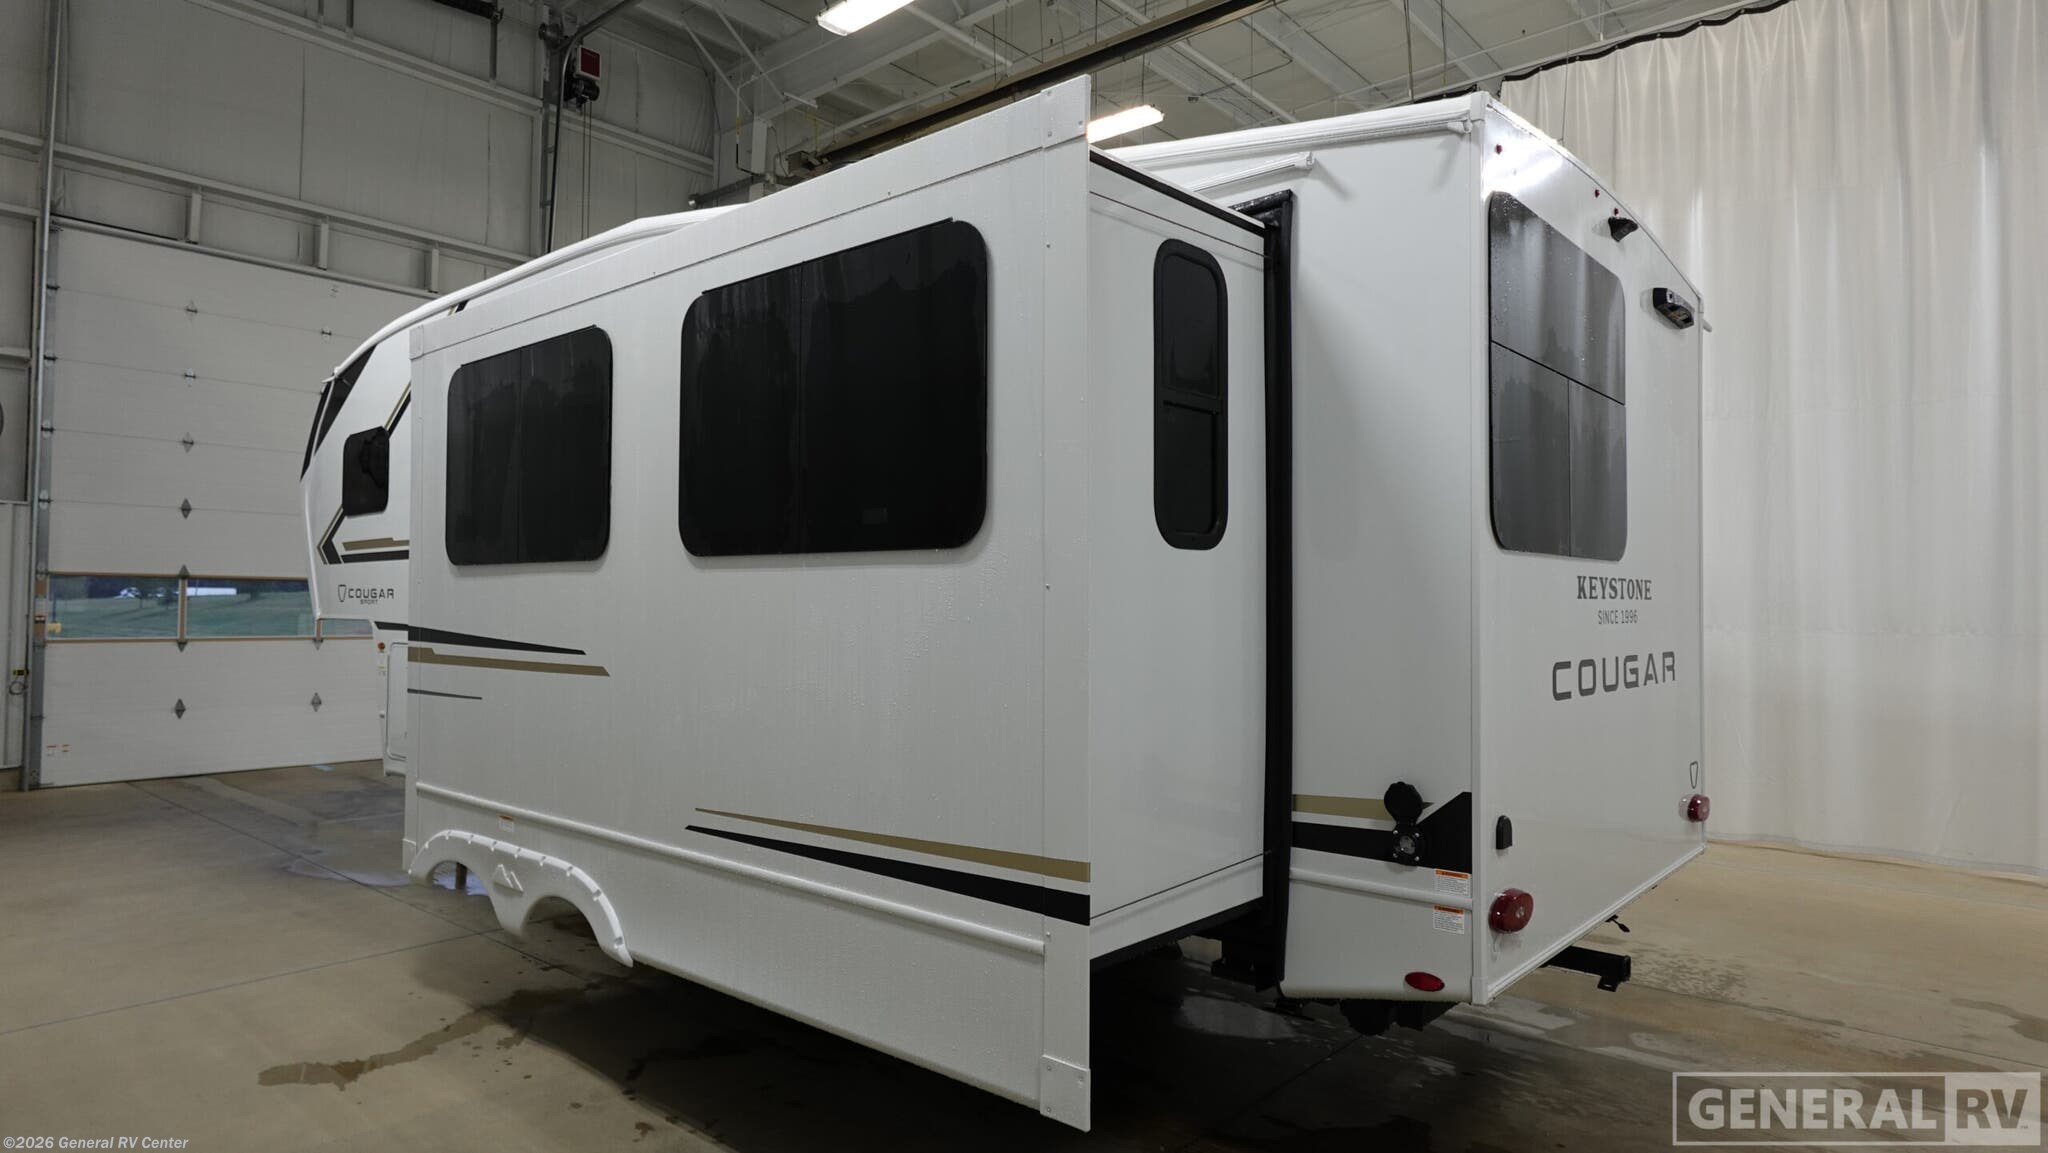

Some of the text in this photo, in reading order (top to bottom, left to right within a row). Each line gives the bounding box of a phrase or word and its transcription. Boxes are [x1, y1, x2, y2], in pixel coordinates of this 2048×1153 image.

[347, 588, 394, 599] COUGAR
[1577, 575, 1652, 600] KEYSTONE
[1598, 609, 1638, 625] SINCE 1996
[1552, 651, 1676, 701] COUGAR
